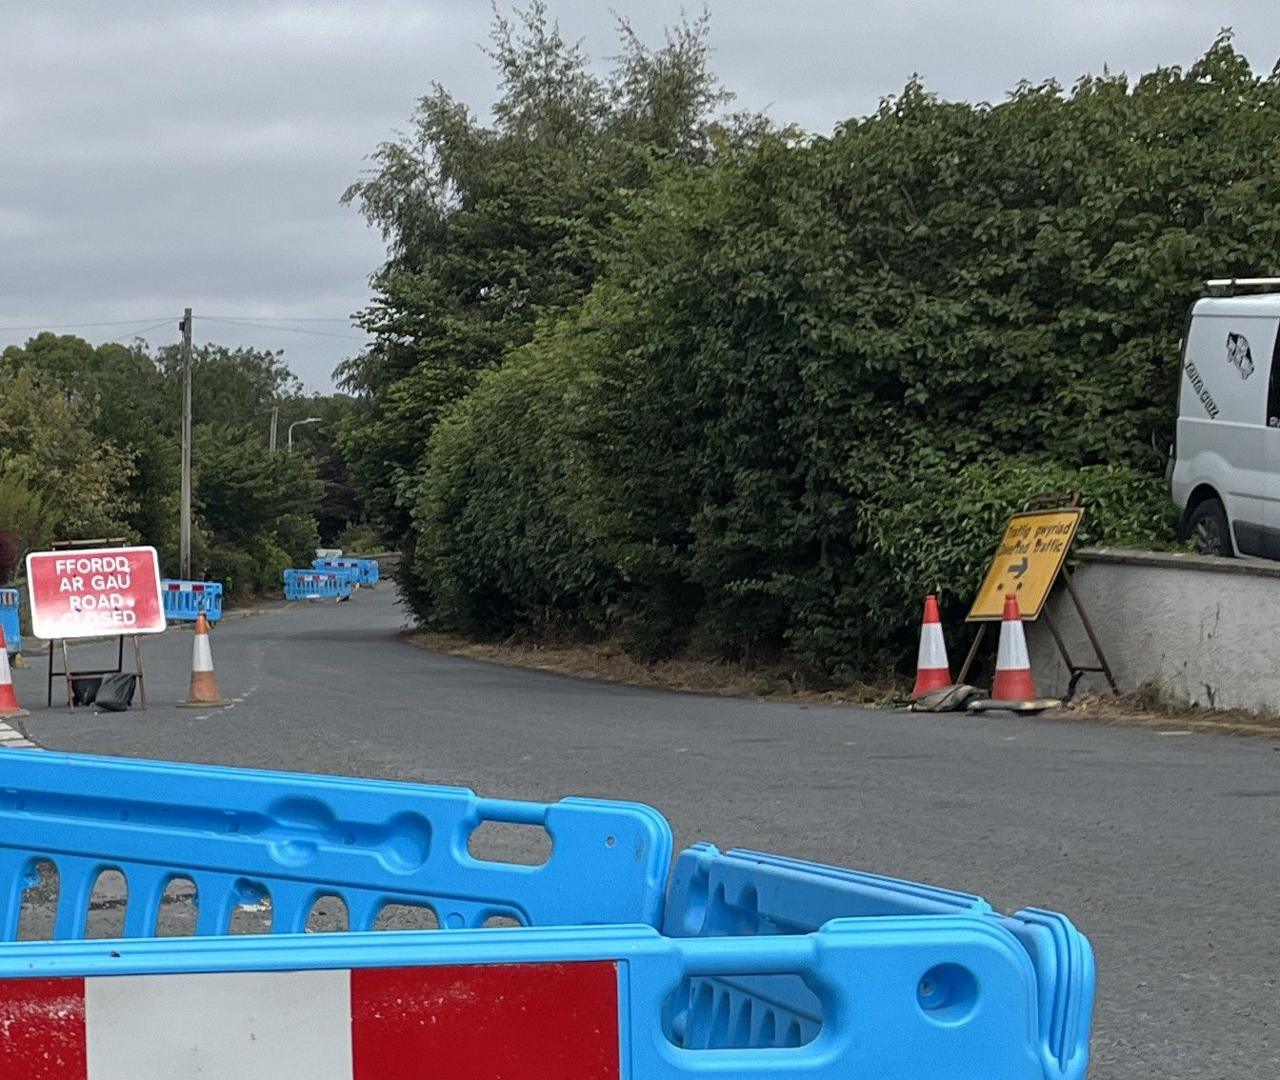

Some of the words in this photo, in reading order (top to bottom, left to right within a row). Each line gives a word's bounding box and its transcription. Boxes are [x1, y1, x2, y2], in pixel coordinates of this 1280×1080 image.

[60, 576, 84, 592] AR
[91, 574, 131, 591] GAU
[69, 593, 123, 609] ROAD
